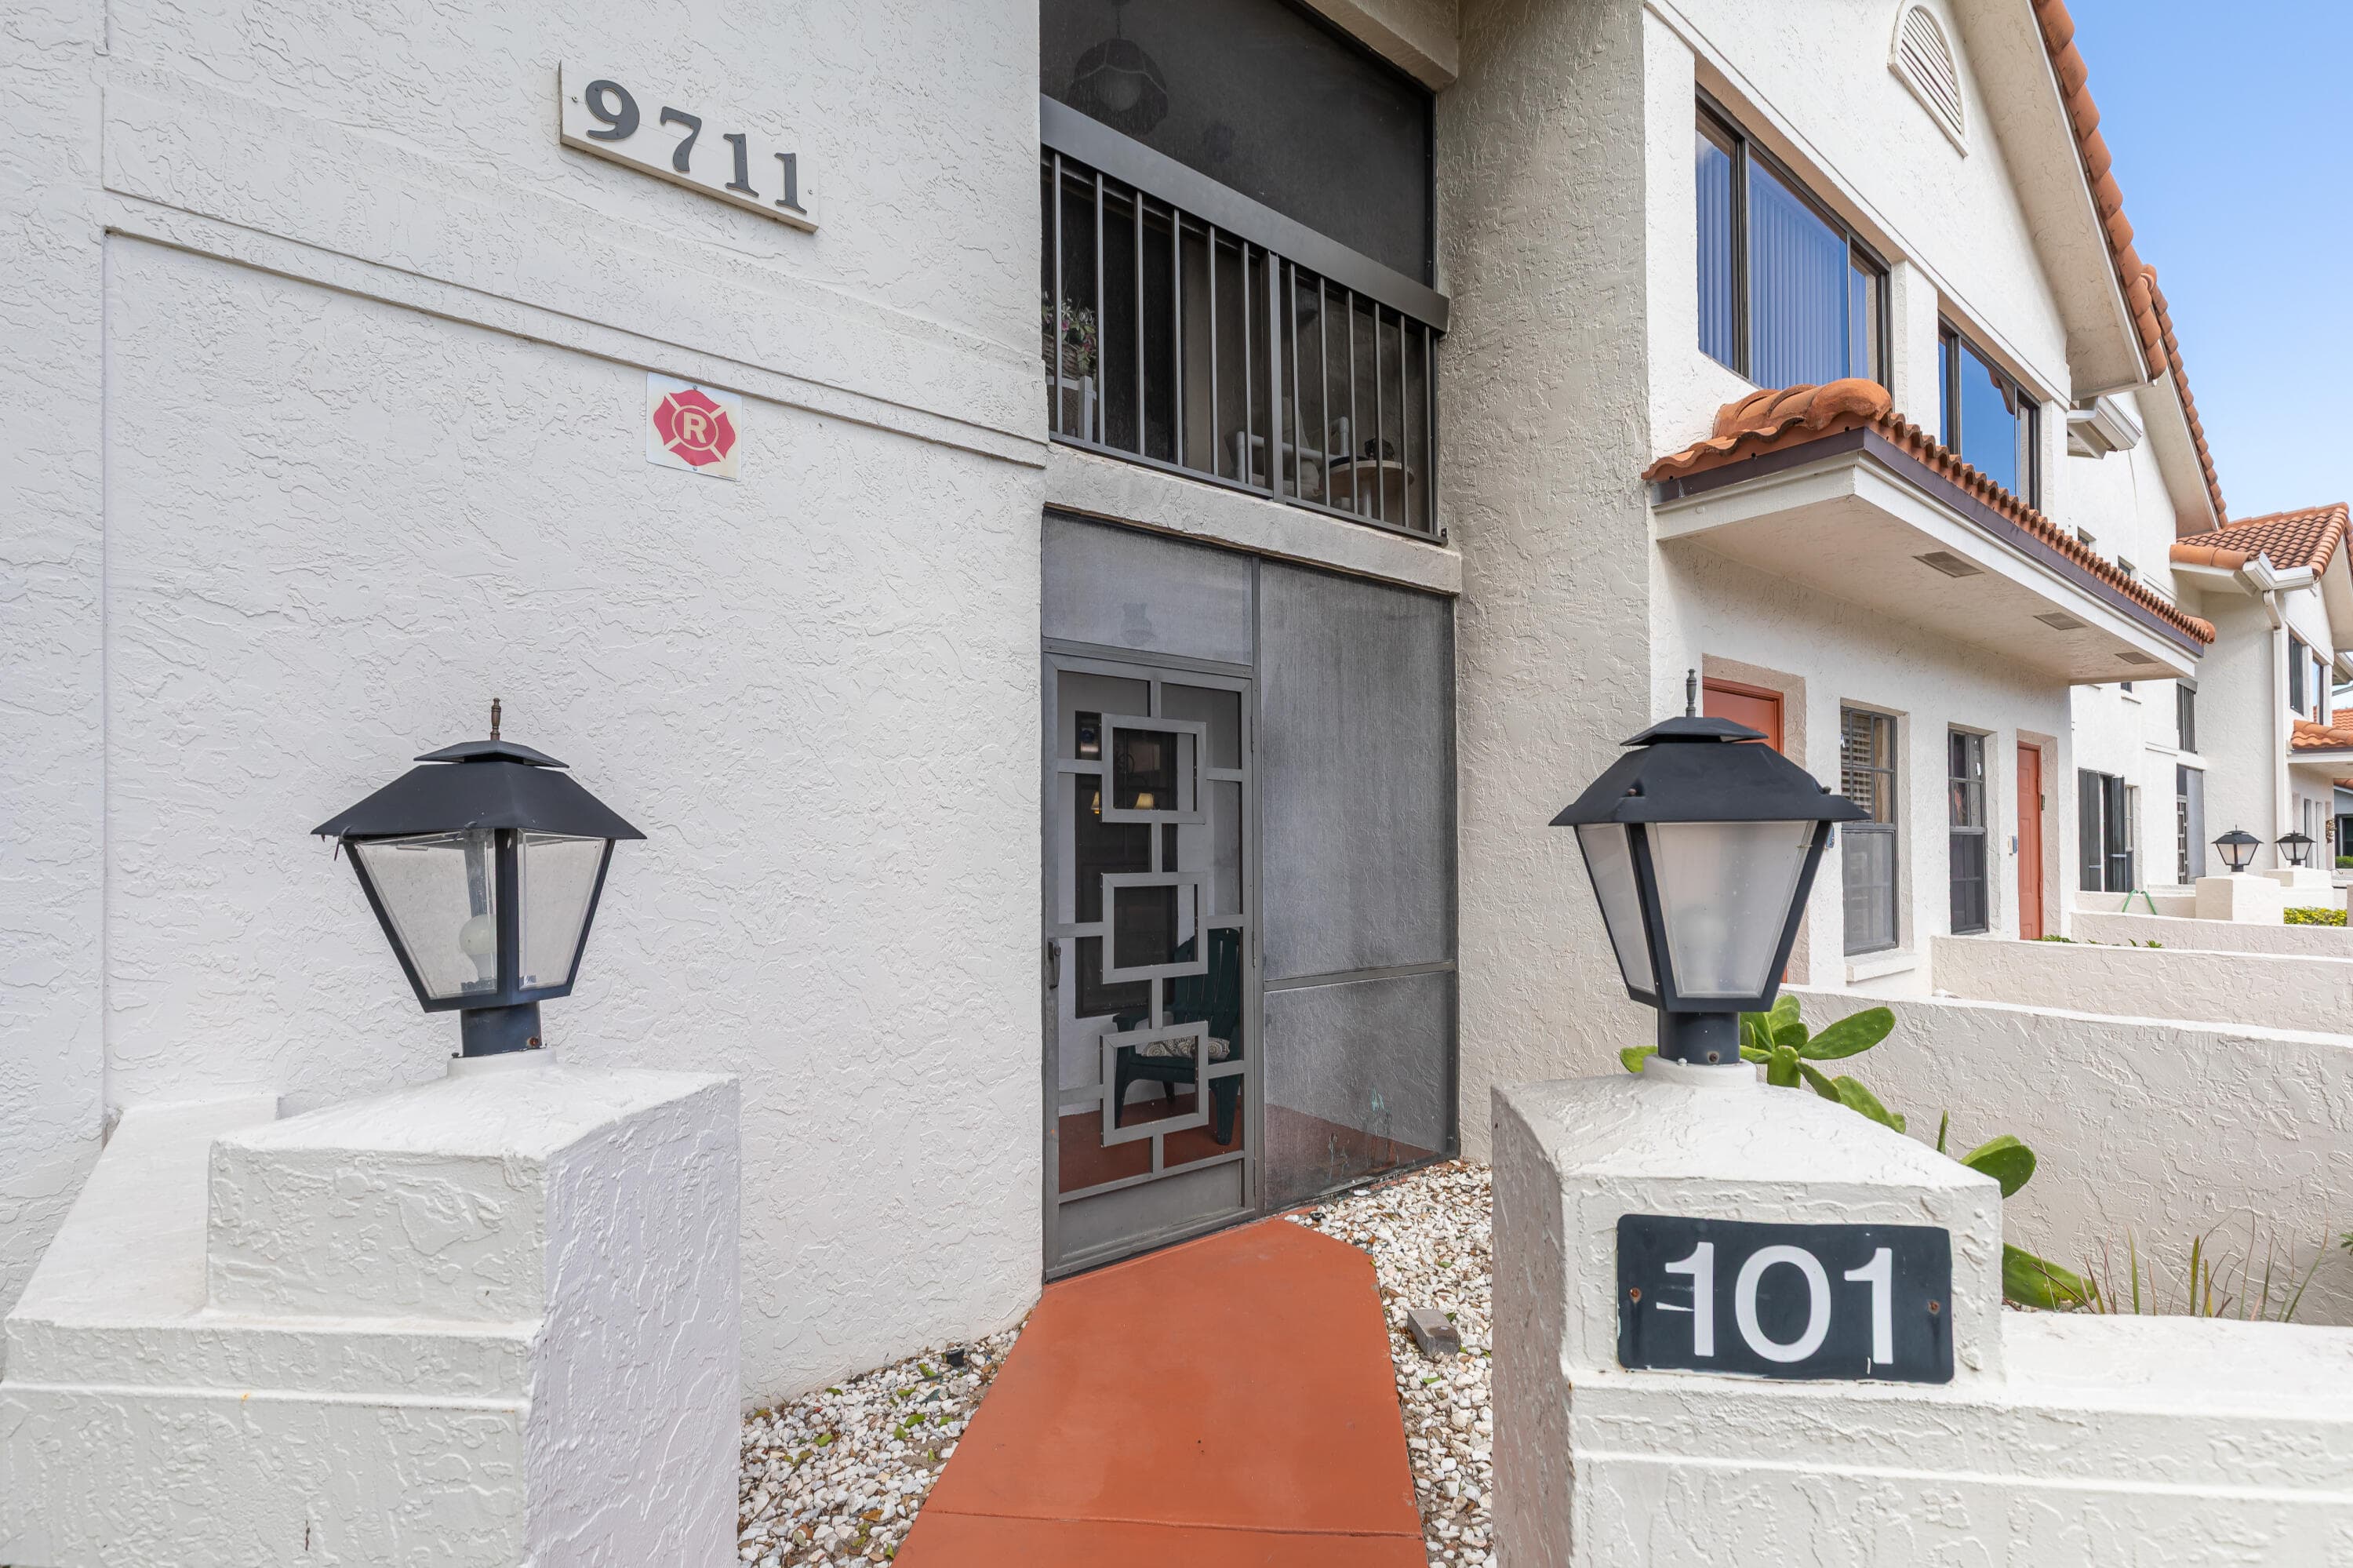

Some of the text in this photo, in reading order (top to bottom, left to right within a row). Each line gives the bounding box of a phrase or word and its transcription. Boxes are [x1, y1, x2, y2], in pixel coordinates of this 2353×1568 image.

[585, 79, 807, 214] 9711
[683, 411, 707, 443] R
[1665, 1242, 1893, 1364] 101
